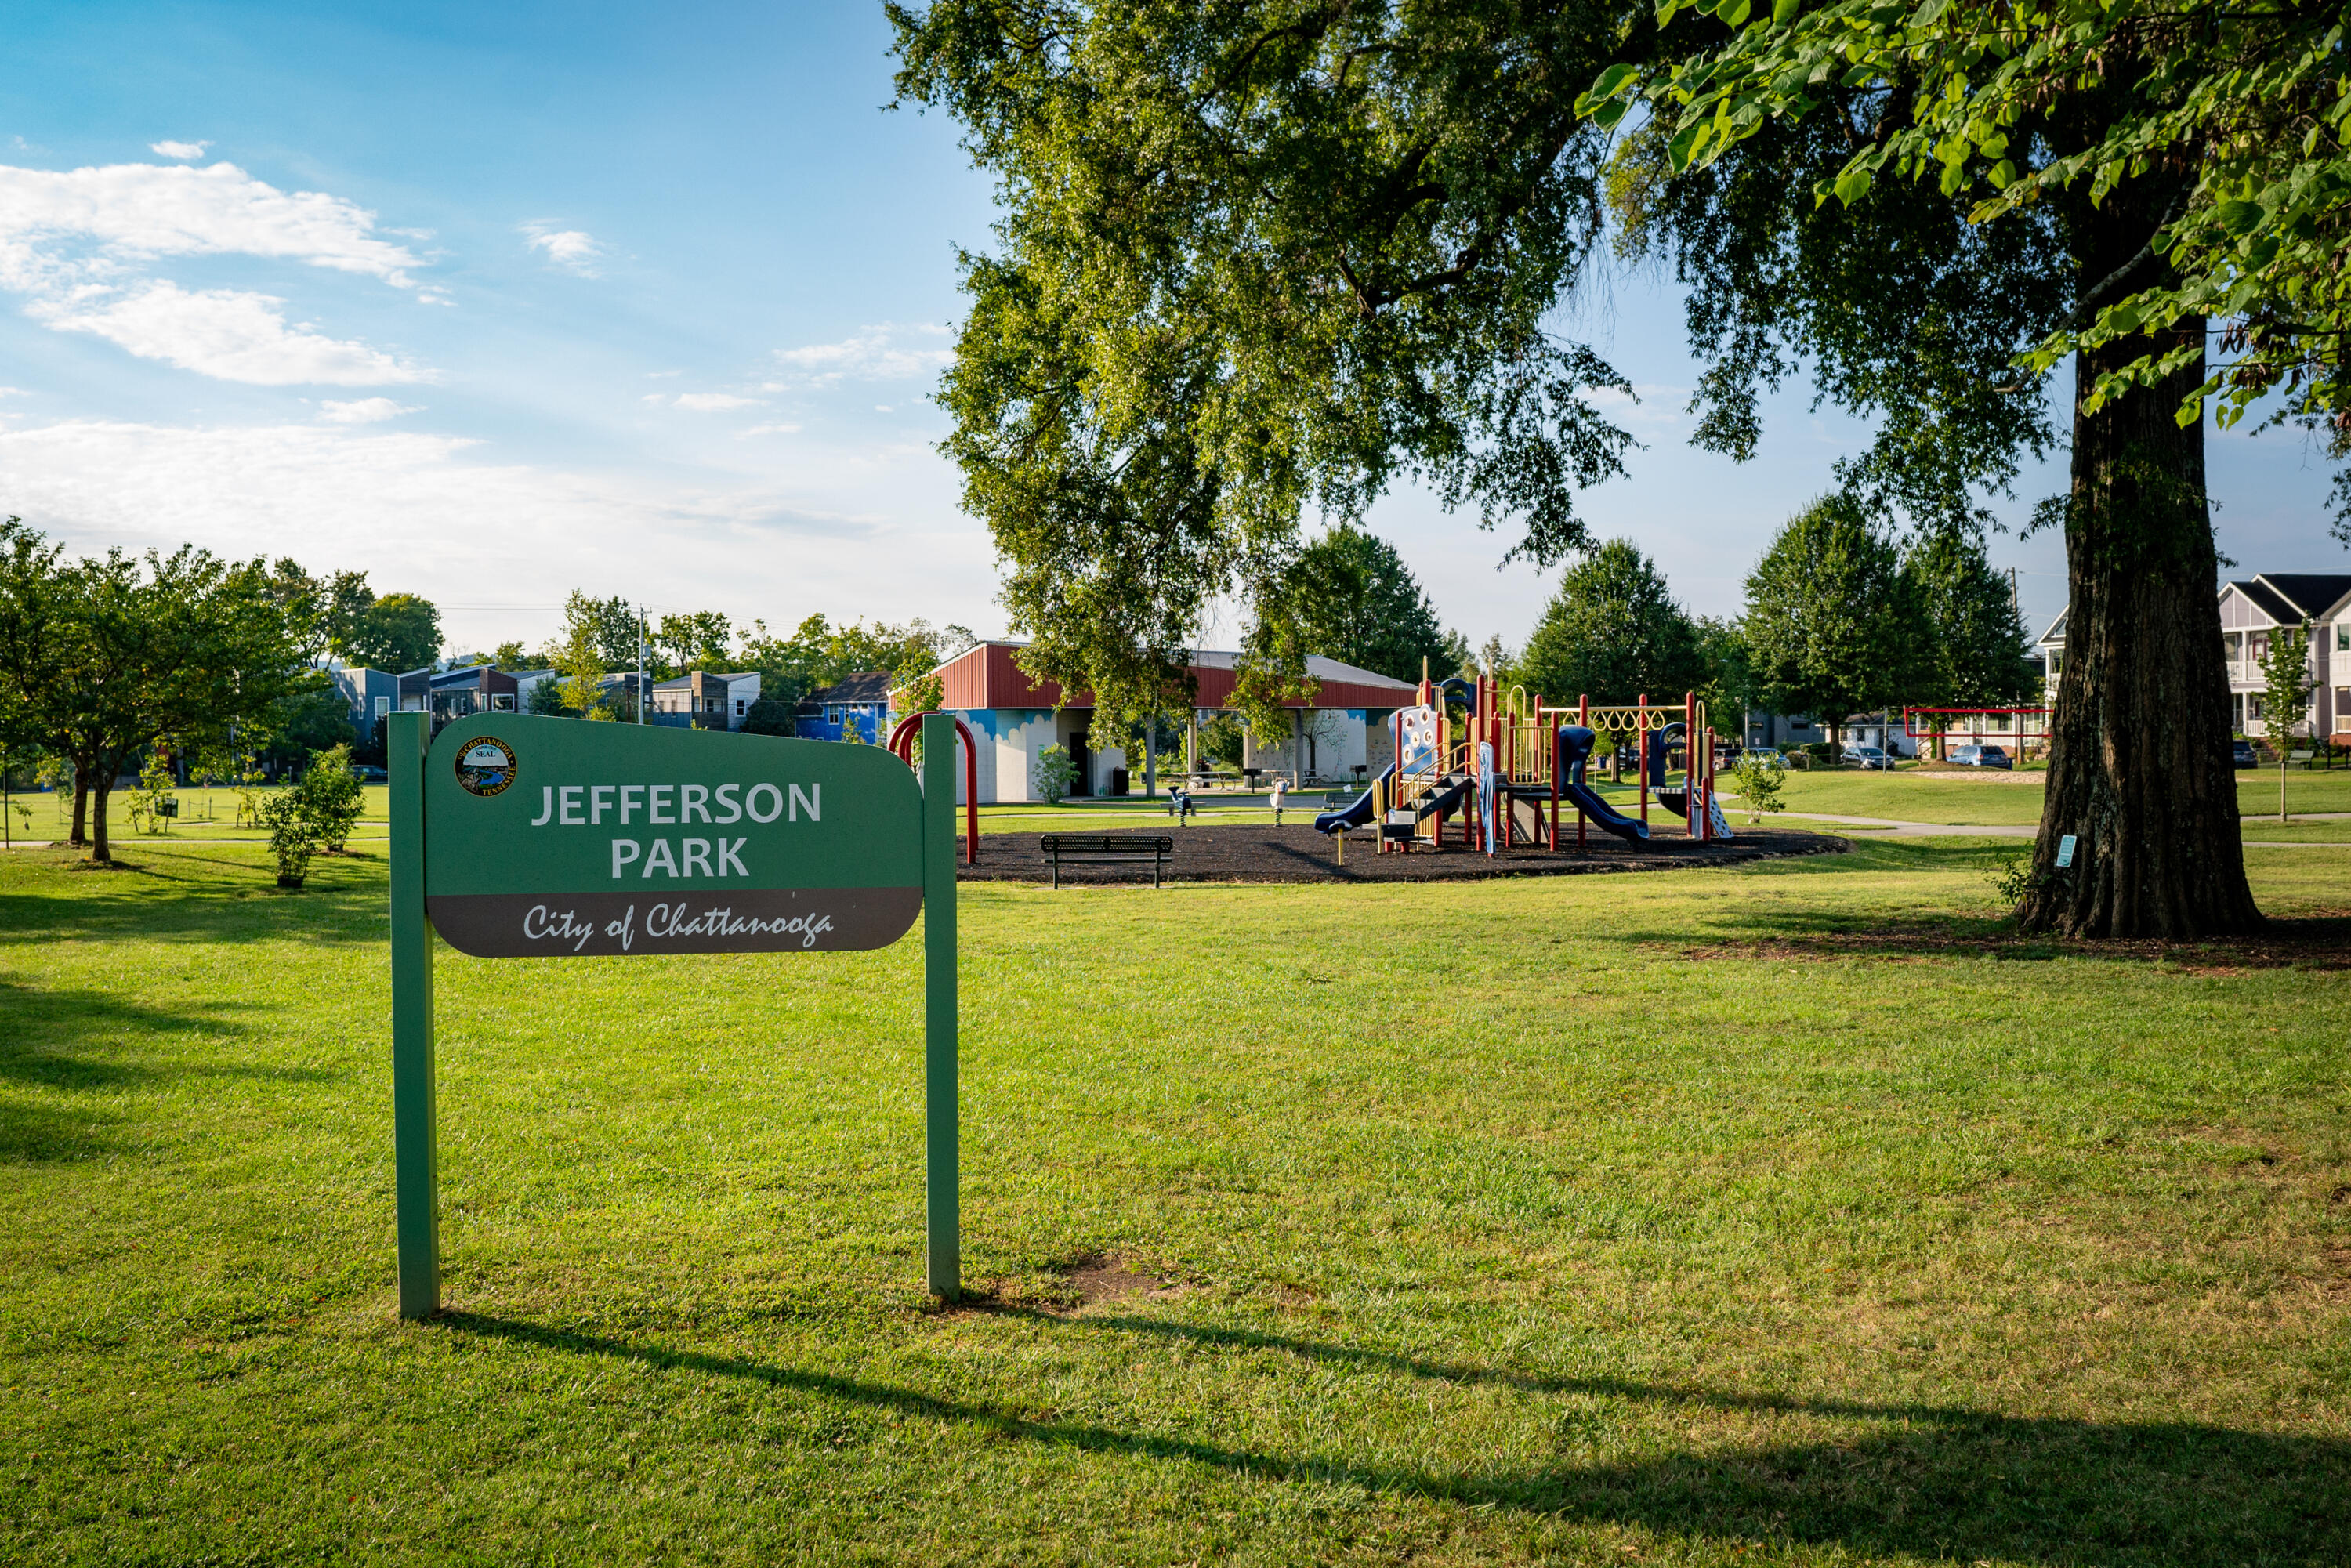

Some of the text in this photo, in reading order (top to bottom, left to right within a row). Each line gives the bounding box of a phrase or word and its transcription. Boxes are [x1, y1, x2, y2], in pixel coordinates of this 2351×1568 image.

[464, 737, 513, 759] CHATTANOOGA
[482, 766, 516, 796] TENNESSEE
[531, 783, 820, 826] JEFFERSON
[611, 838, 750, 878] PARK
[523, 902, 834, 951] City of Chattanooga
